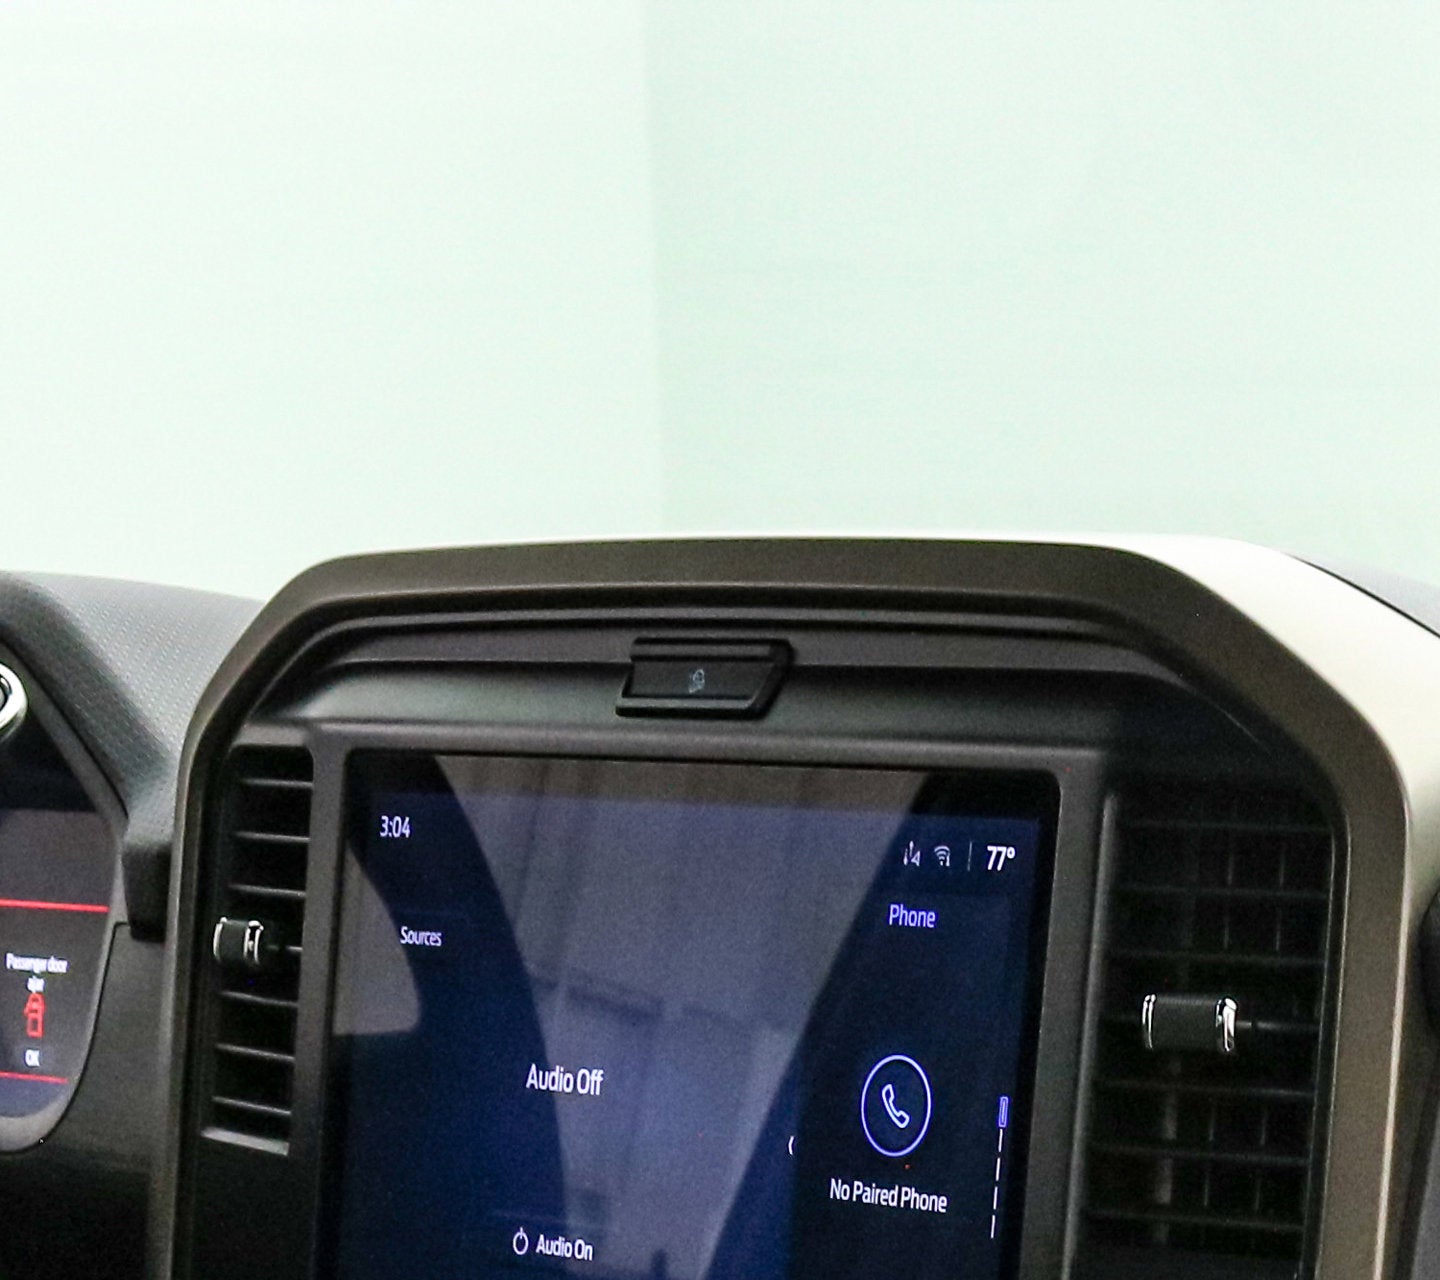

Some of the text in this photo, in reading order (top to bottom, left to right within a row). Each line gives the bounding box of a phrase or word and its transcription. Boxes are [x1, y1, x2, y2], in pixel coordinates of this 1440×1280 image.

[379, 815, 411, 838] 3:04
[888, 903, 938, 929] Phone
[399, 925, 442, 947] Sources
[525, 1063, 605, 1096] Audio Off
[829, 1177, 948, 1213] No Paired Phone
[535, 1233, 593, 1261] Audio On
